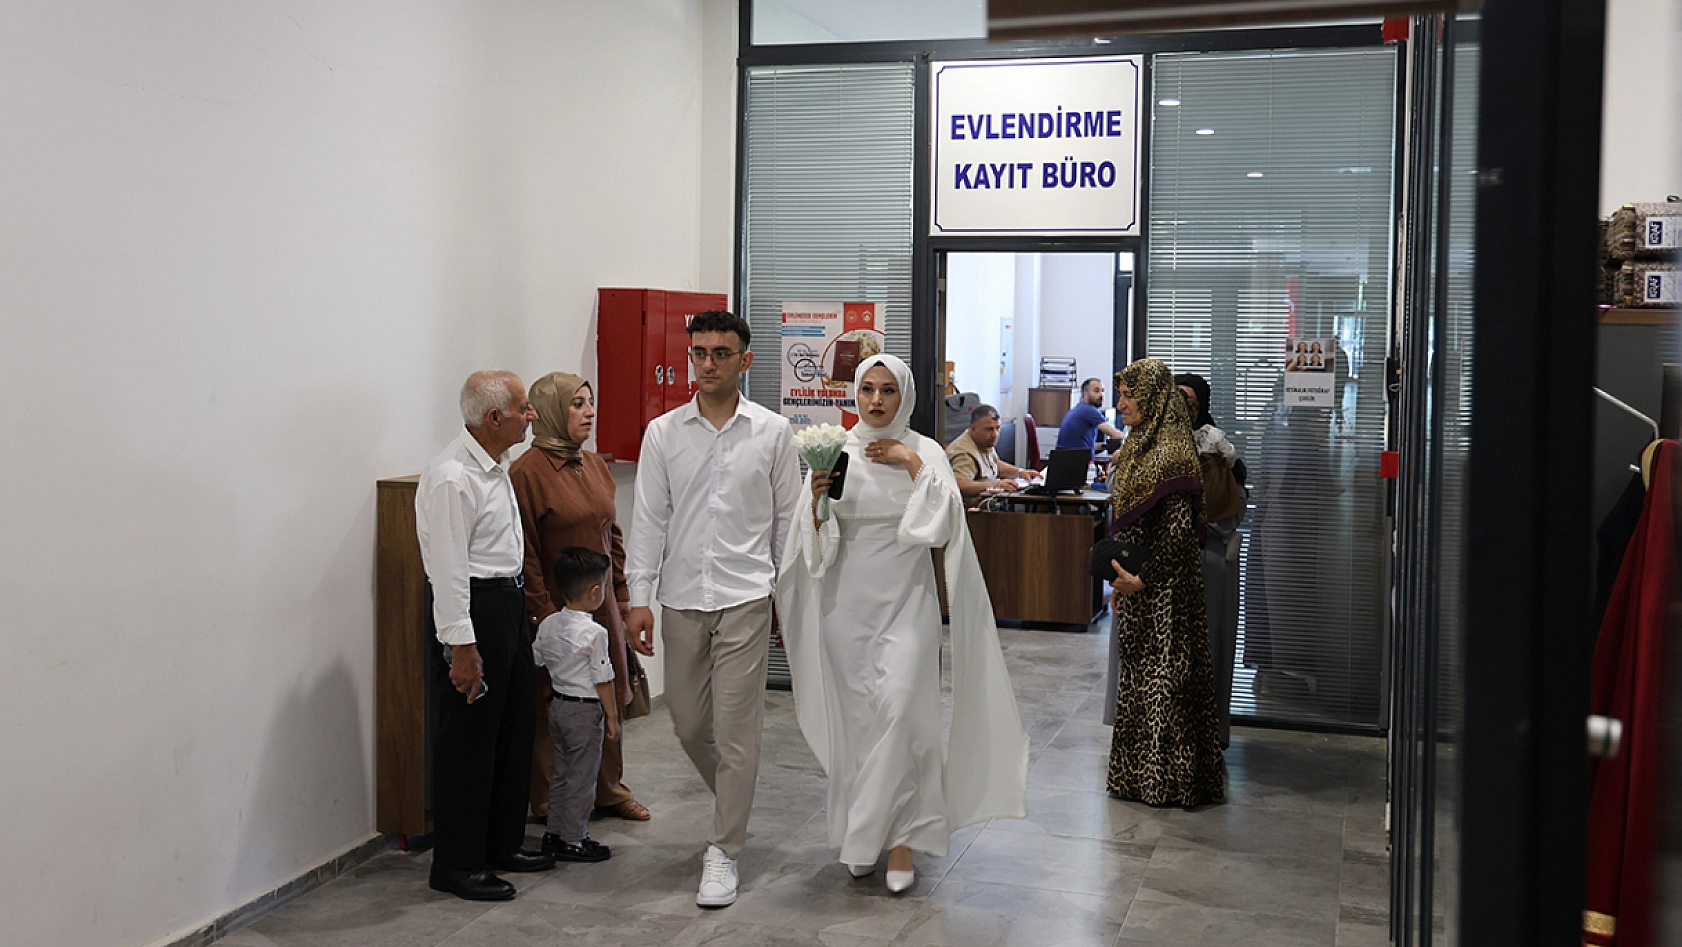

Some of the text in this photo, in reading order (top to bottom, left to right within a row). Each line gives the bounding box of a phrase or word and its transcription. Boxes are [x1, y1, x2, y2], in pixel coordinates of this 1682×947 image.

[950, 105, 1121, 140] EVLENDİRME
[954, 156, 1116, 189] KAYIT BÜRO
[790, 386, 846, 398] EVLİLİK YOLUNDA
